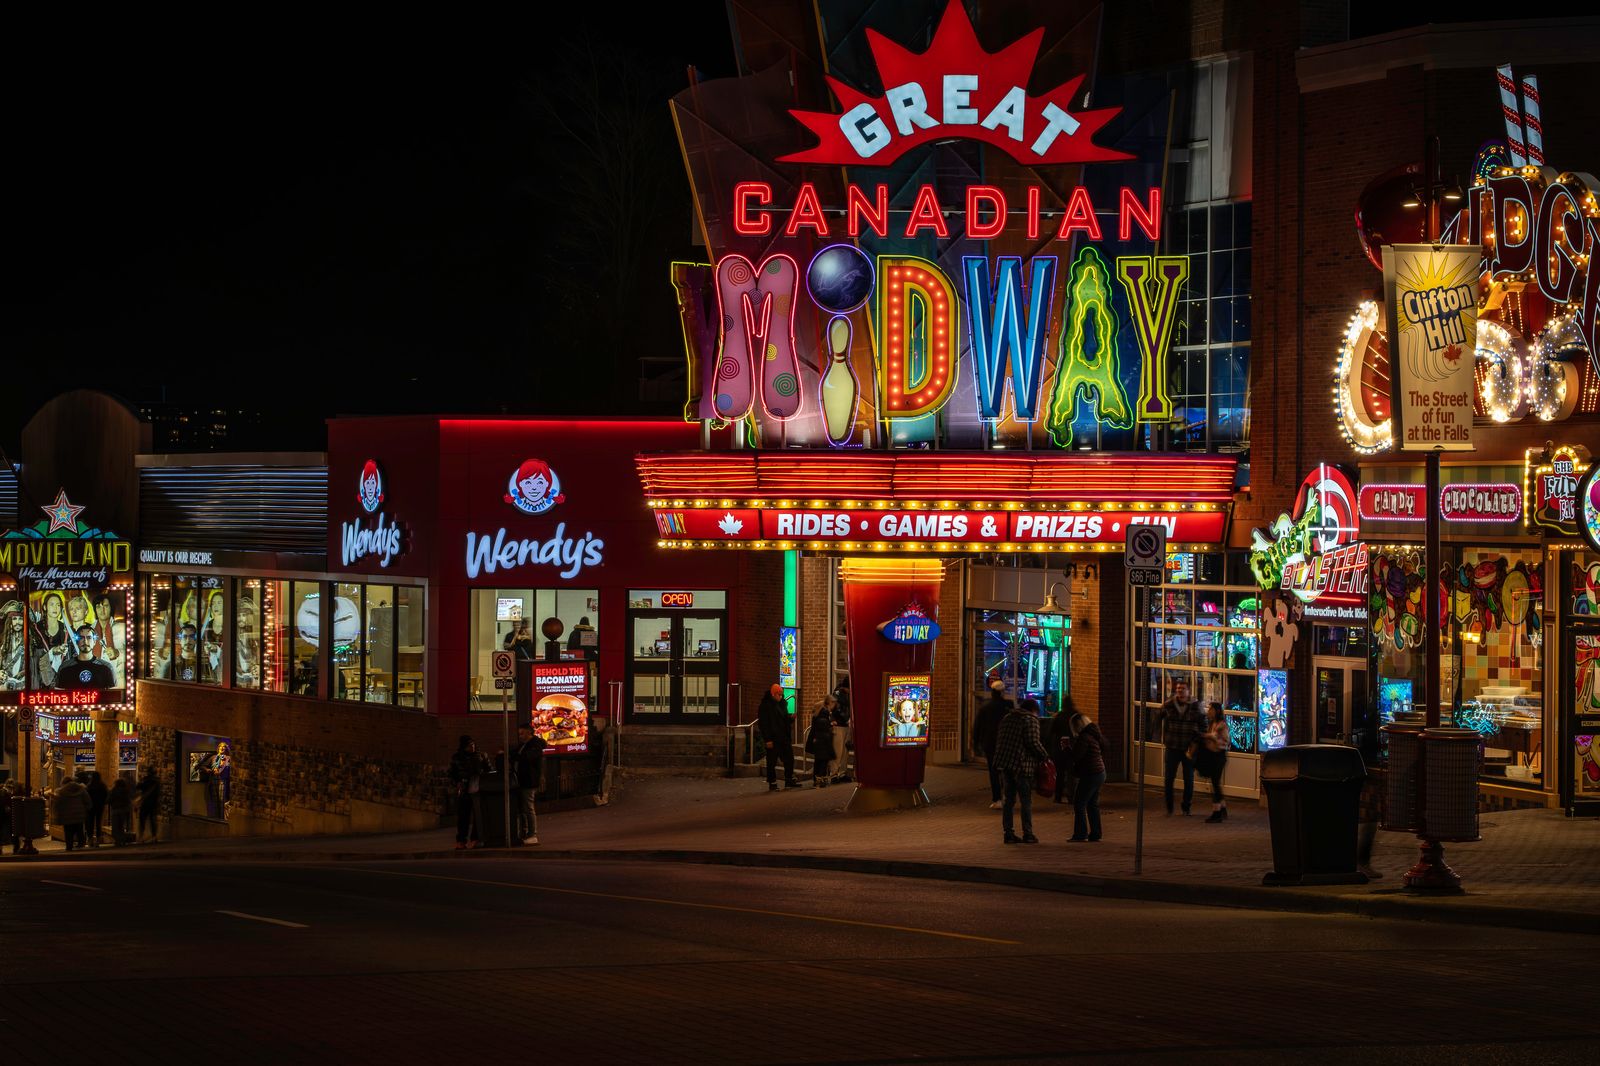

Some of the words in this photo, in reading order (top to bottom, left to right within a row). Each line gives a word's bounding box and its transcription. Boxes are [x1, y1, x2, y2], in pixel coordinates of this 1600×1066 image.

[838, 74, 1081, 159] GREAT
[733, 182, 1163, 241] CANADIAN
[1403, 284, 1474, 324] Clifton
[1424, 315, 1468, 352] Hill
[1409, 391, 1430, 407] The
[1432, 391, 1468, 407] Street
[1422, 408, 1434, 424] of
[1436, 408, 1455, 424] fun
[1408, 427, 1419, 441] at
[1422, 426, 1441, 441] the
[1444, 425, 1469, 441] Falls
[1554, 460, 1574, 475] THE
[1543, 474, 1581, 500] FUD
[1373, 490, 1414, 516] CANDY
[1443, 487, 1517, 514] CHOCOLATE
[778, 513, 850, 536] RIDES
[879, 514, 968, 537] GAMES
[980, 515, 998, 537] &
[1015, 515, 1103, 538] PRIZES
[342, 512, 400, 568] Wendy's
[466, 522, 604, 579] Wendy's
[1250, 503, 1318, 590] GHOST
[0, 541, 131, 573] MOVIELAND
[140, 549, 166, 562] QUALITY
[168, 551, 173, 563] IS
[175, 551, 188, 564] OUR
[190, 552, 212, 565] RECIPE
[19, 567, 43, 580] Wax
[43, 566, 91, 579] Museum
[93, 566, 106, 583] of
[35, 578, 55, 590] The
[57, 577, 89, 590] Stars
[662, 593, 692, 605] OPEN
[1305, 604, 1337, 617] Interactive
[1338, 606, 1354, 618] Dark
[536, 668, 568, 676] BEHOLD
[569, 667, 584, 675] THE
[536, 675, 585, 685] BACONATOR
[72, 692, 98, 704] Kaif
